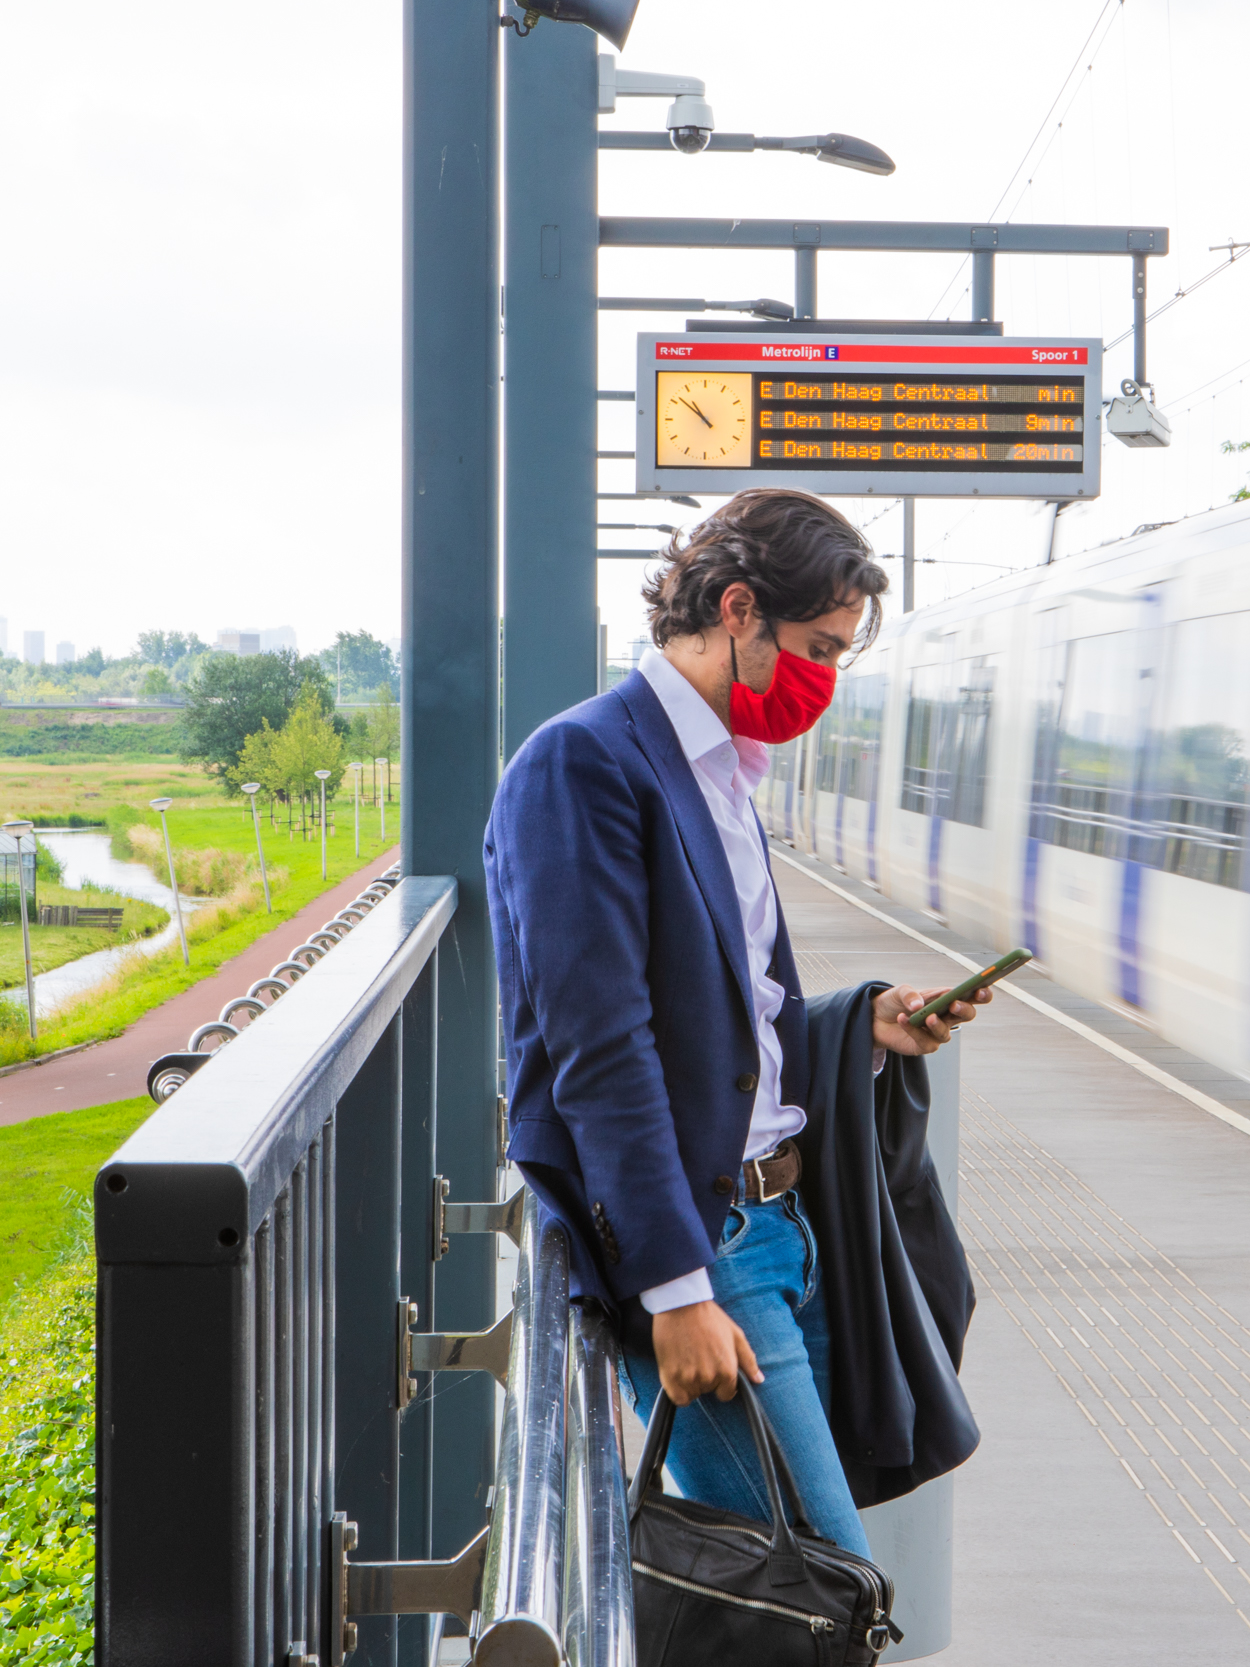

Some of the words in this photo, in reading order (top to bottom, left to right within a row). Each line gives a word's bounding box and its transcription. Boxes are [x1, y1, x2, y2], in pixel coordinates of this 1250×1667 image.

[761, 346, 821, 360] Metrolijn
[827, 347, 836, 358] E
[1031, 349, 1068, 362] Spoor
[1072, 350, 1078, 361] 1
[760, 381, 773, 398] E
[784, 382, 821, 398] Den
[833, 382, 882, 401] Haag
[893, 383, 988, 401] Centraal
[1038, 385, 1075, 402] min
[760, 410, 773, 427] E
[784, 411, 821, 427] Den
[833, 411, 882, 430] Haag
[893, 412, 988, 430] Centraal
[1026, 414, 1075, 431] 9min
[760, 440, 773, 457] E
[784, 441, 821, 457] Den
[833, 441, 882, 460] Haag
[893, 442, 988, 460] Centraal
[1013, 444, 1075, 461] 20min
